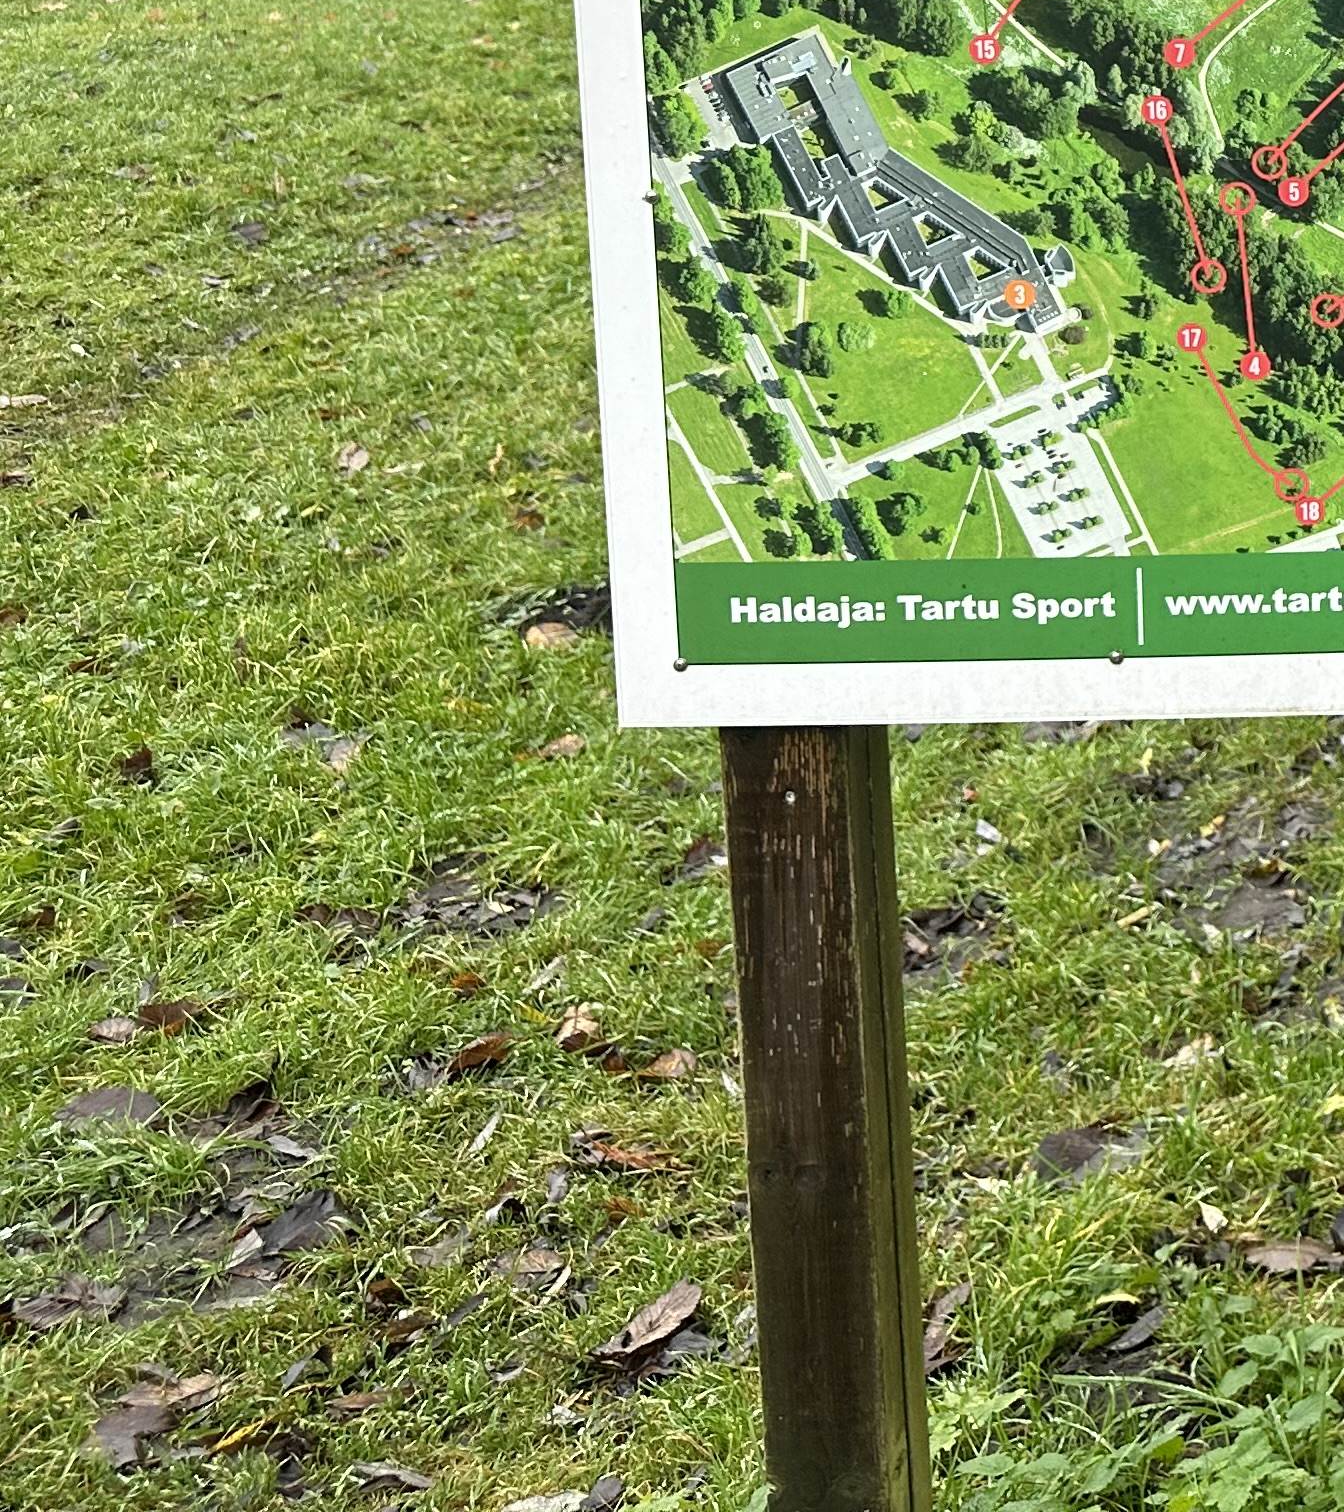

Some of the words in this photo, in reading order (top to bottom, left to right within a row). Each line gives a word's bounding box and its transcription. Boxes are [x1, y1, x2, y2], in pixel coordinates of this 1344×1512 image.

[975, 40, 995, 59] 15
[1147, 101, 1166, 119] 16
[1182, 329, 1201, 347] 17
[1300, 502, 1319, 520] 18
[730, 595, 886, 629] Haldaja:
[896, 594, 1000, 621] Tartu
[1011, 591, 1116, 625] Sport
